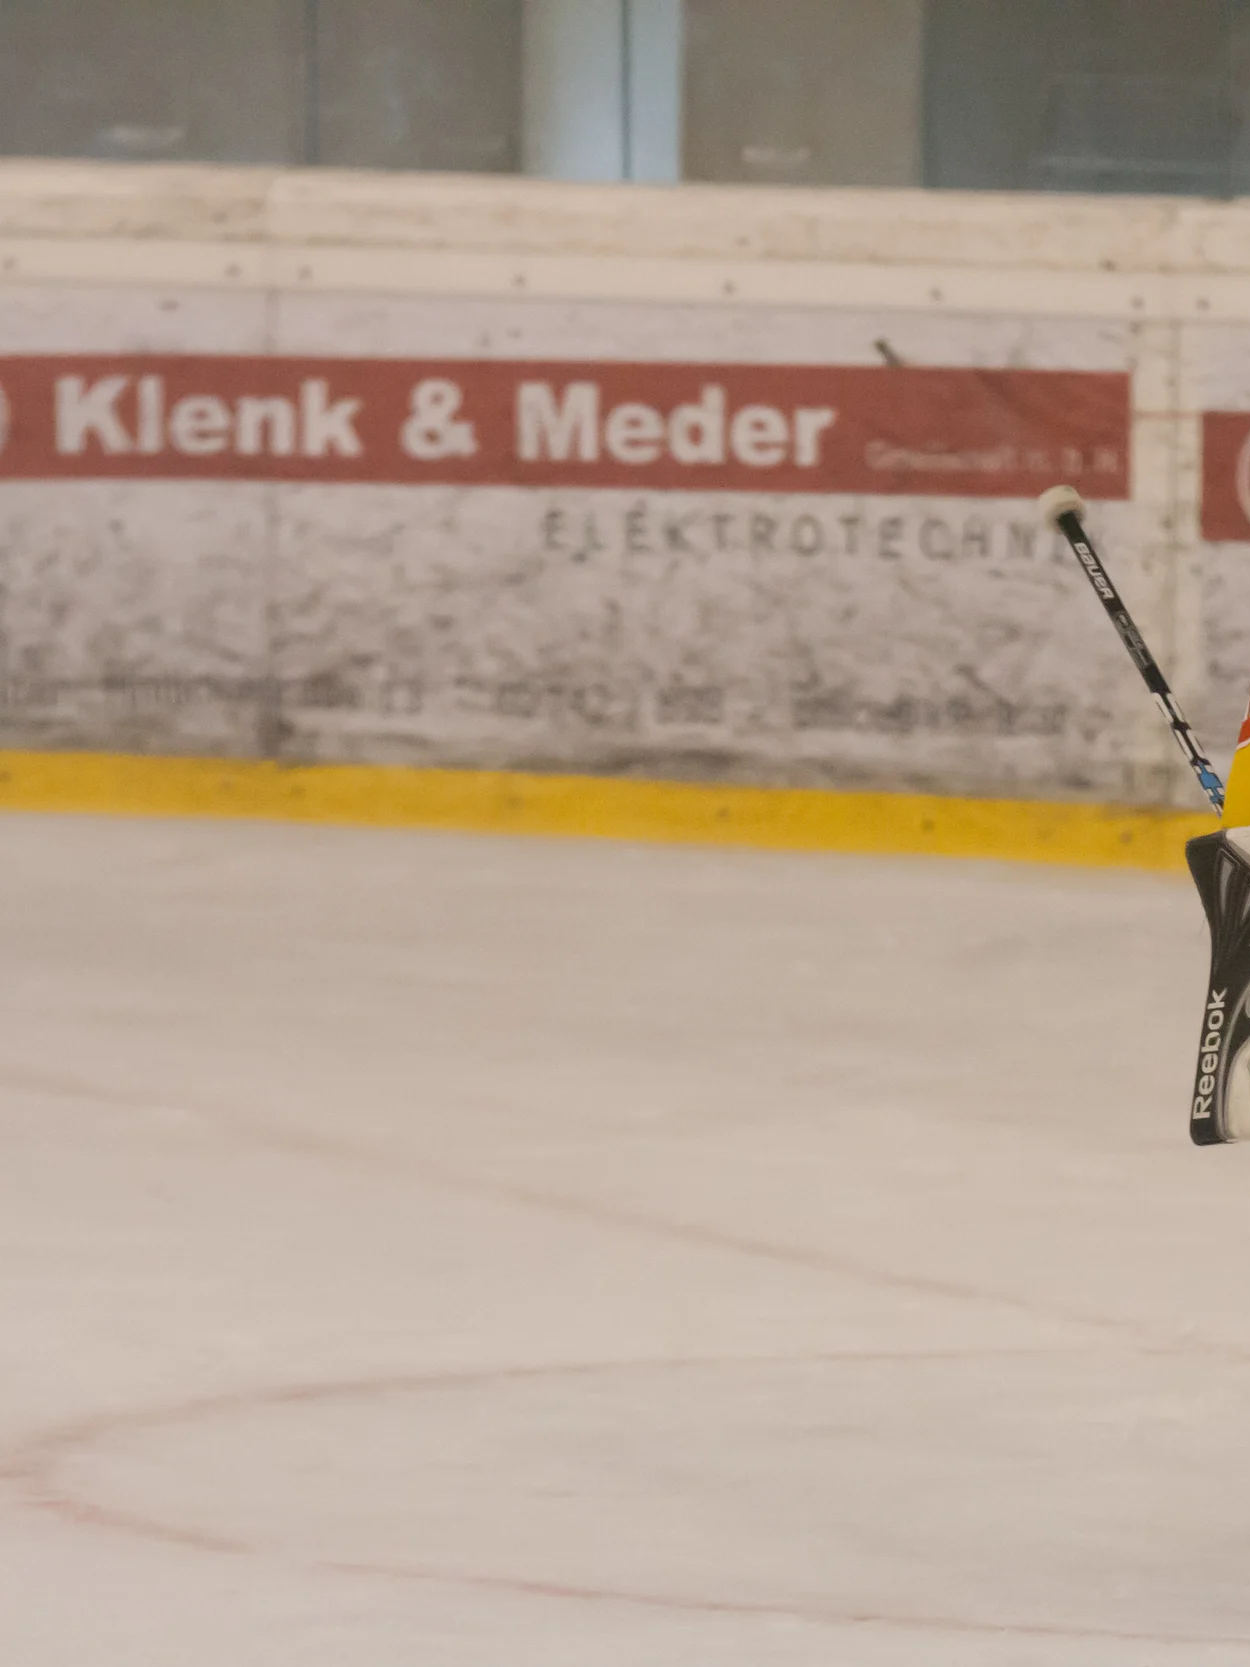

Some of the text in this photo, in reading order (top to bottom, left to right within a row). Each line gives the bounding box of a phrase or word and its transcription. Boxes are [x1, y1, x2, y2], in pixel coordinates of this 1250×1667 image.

[55, 374, 363, 459] Klenk
[402, 378, 478, 460] &
[516, 380, 837, 467] Meder
[1192, 987, 1228, 1120] Reebok
